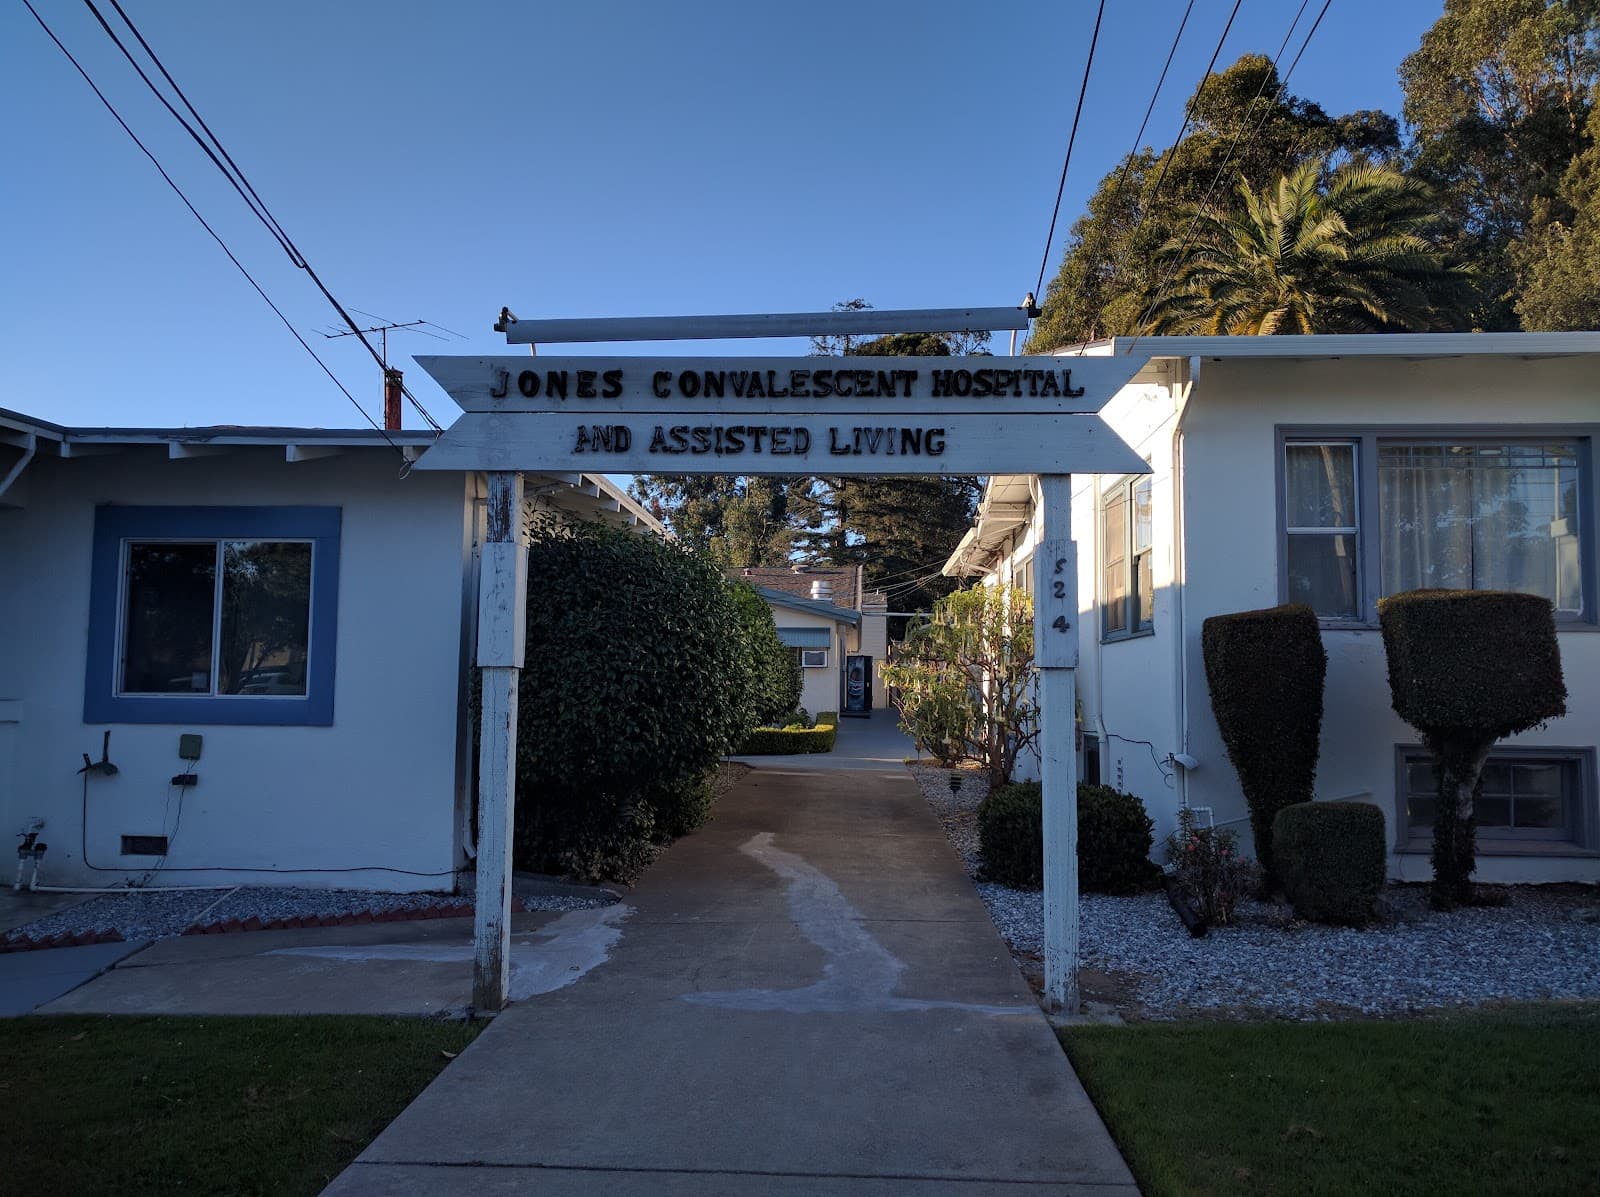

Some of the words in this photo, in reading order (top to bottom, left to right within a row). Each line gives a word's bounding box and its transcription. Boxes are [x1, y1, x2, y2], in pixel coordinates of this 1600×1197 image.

[490, 369, 623, 401] JONES
[652, 370, 918, 398] CONVALESCENT
[932, 369, 1084, 398] HOSPITAL
[574, 425, 632, 453] AND
[650, 425, 810, 456] ASSISTED
[829, 427, 945, 456] LIVING
